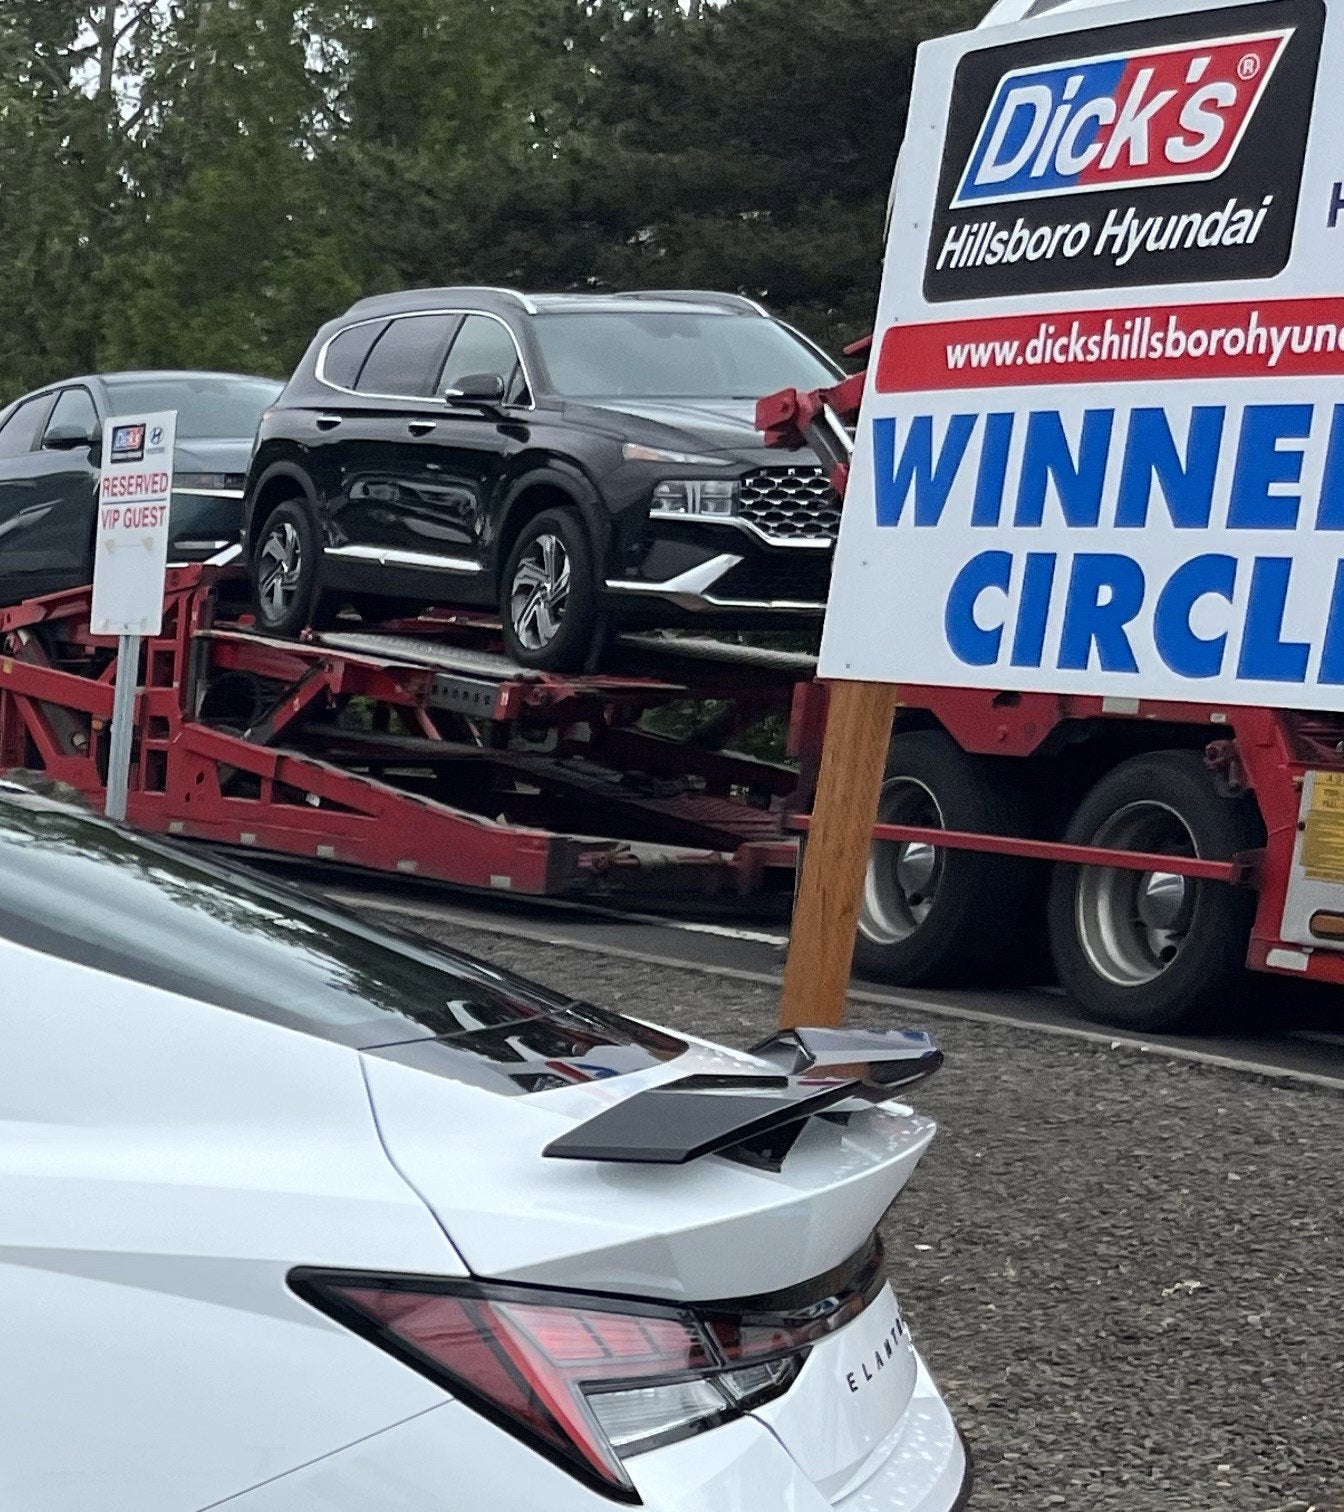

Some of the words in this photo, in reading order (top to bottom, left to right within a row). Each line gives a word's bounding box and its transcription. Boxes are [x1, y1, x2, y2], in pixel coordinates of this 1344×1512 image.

[973, 56, 1236, 186] Dick's
[935, 220, 1090, 271] Hillsboro
[1093, 195, 1274, 267] Hyundai
[946, 310, 1344, 370] www.dickshillsborohyun
[102, 472, 169, 499] RESERVED
[871, 403, 1344, 531] WINNE
[101, 508, 120, 530] VIP
[123, 505, 167, 529] GUEST
[944, 549, 1344, 685] CIRCL
